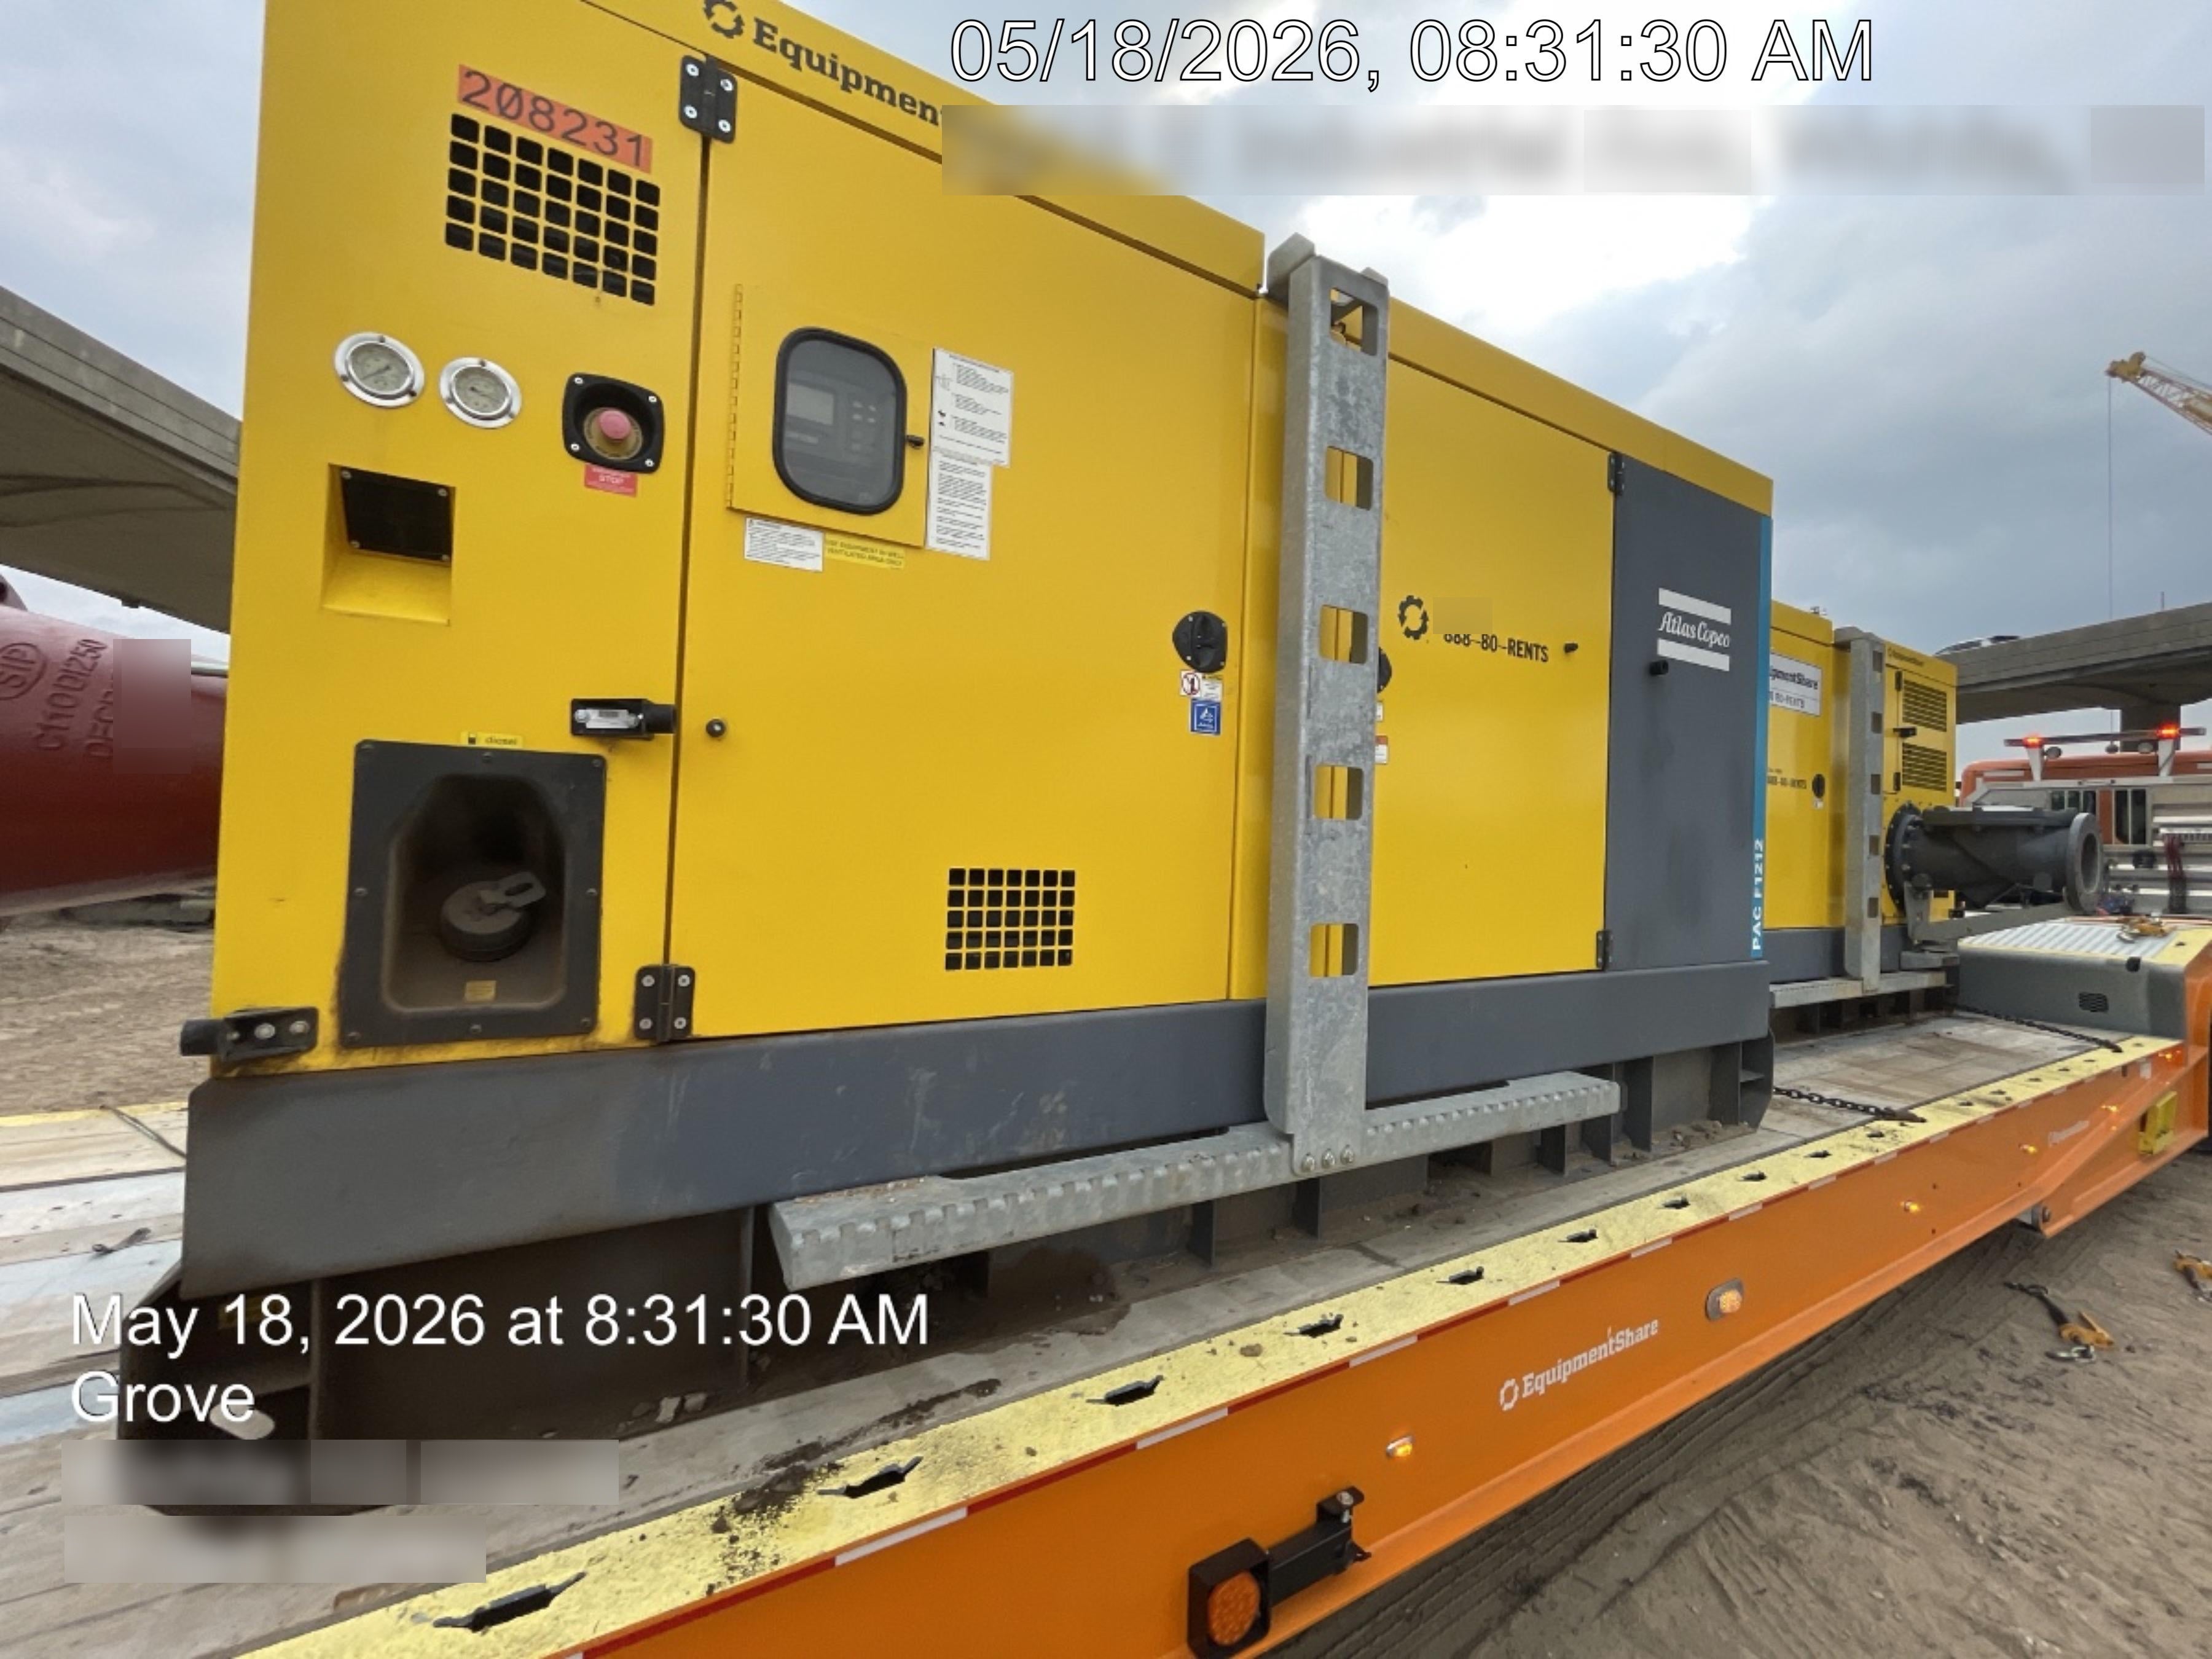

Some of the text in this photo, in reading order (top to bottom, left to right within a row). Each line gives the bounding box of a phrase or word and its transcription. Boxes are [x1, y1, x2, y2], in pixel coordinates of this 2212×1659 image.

[462, 69, 641, 167] 208231
[753, 17, 943, 126] Equipmen
[1657, 611, 1731, 648] Atlas Copco
[1752, 839, 1764, 950] PAC F1212
[1522, 1319, 1658, 1398] EquipmentShare
